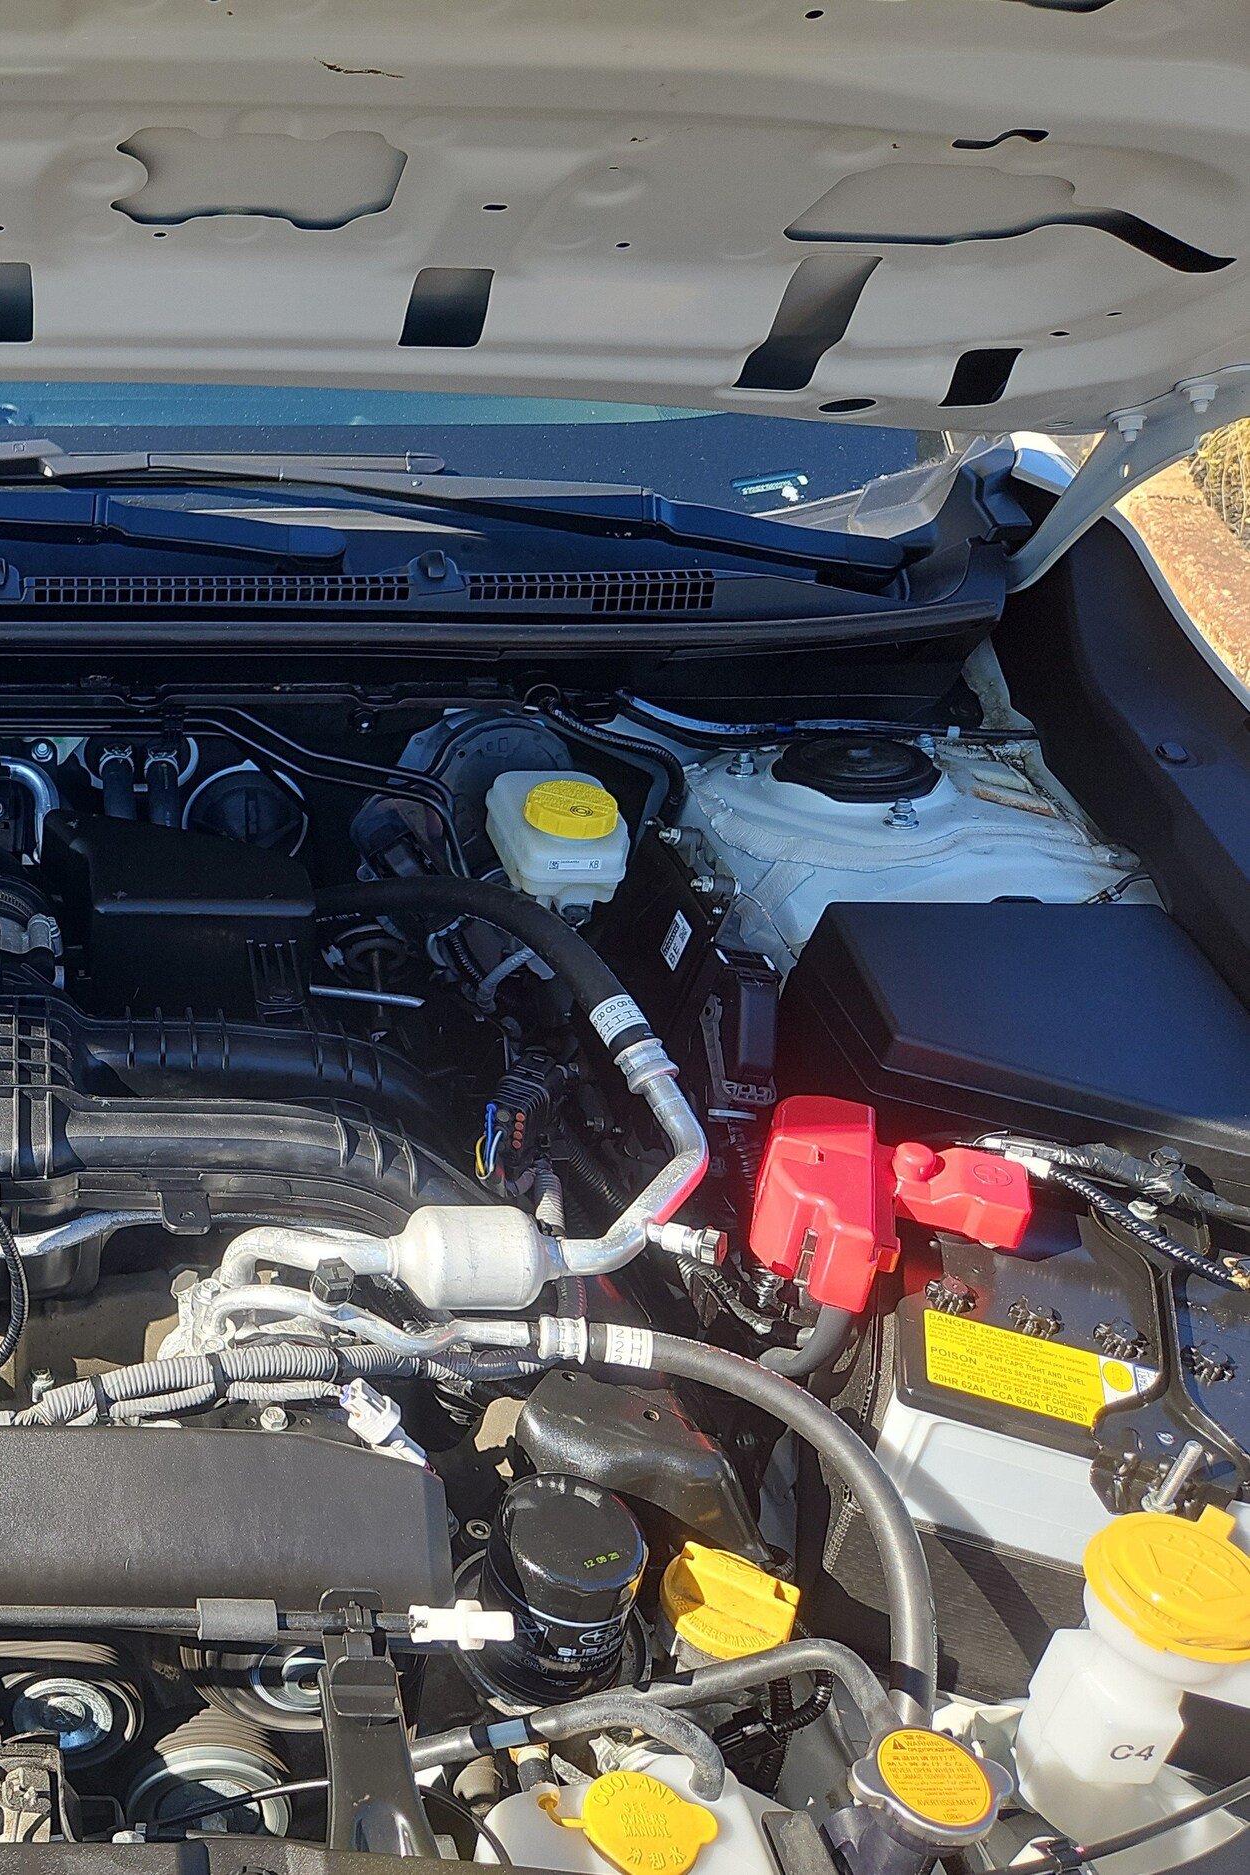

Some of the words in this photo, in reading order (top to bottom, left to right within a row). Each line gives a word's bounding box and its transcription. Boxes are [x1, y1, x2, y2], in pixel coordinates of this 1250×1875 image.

[589, 860, 600, 869] KB
[615, 1328, 624, 1339] 2
[631, 1330, 643, 1341] H
[928, 1312, 976, 1331] DANGER
[981, 1327, 1017, 1341] EXPLOSIVE
[1020, 1337, 1042, 1348] GASES
[615, 1342, 624, 1353] 2
[631, 1343, 642, 1355] H
[614, 1354, 623, 1363] 2
[630, 1357, 641, 1366] H
[930, 1346, 976, 1365] POISON
[984, 1361, 1012, 1374] CAUSES
[1014, 1370, 1041, 1382] SEVERE
[1043, 1377, 1067, 1389] BURNS
[965, 1348, 983, 1358] KEEP
[985, 1353, 1002, 1363] VENT
[1004, 1358, 1023, 1369] CAPS
[1026, 1364, 1044, 1374] TIGHT
[1047, 1370, 1061, 1379] AND
[1063, 1374, 1085, 1385] LEVEL
[933, 1372, 958, 1386] 20HR
[961, 1380, 985, 1394] 62Ah
[991, 1388, 1013, 1402] CCA
[1016, 1394, 1040, 1409] 620A
[1045, 1403, 1087, 1422] D23(JIS)
[967, 1374, 985, 1384] KEEP
[987, 1379, 1001, 1389] OUT
[1014, 1387, 1038, 1399] REACH
[1040, 1394, 1050, 1402] OF
[1052, 1397, 1087, 1413] CHILDREN
[583, 1559, 596, 1569] 12
[607, 1551, 620, 1561] 25
[670, 1591, 689, 1611] SEE
[685, 1612, 728, 1643] OWNER'S
[728, 1633, 771, 1649] MANUAL
[548, 1654, 576, 1663] MADE
[1109, 1744, 1154, 1762] C4
[592, 1774, 683, 1807] COOLANT
[622, 1802, 647, 1813] SEE
[620, 1812, 668, 1826] OWNERS
[622, 1825, 672, 1839] MANUAL
